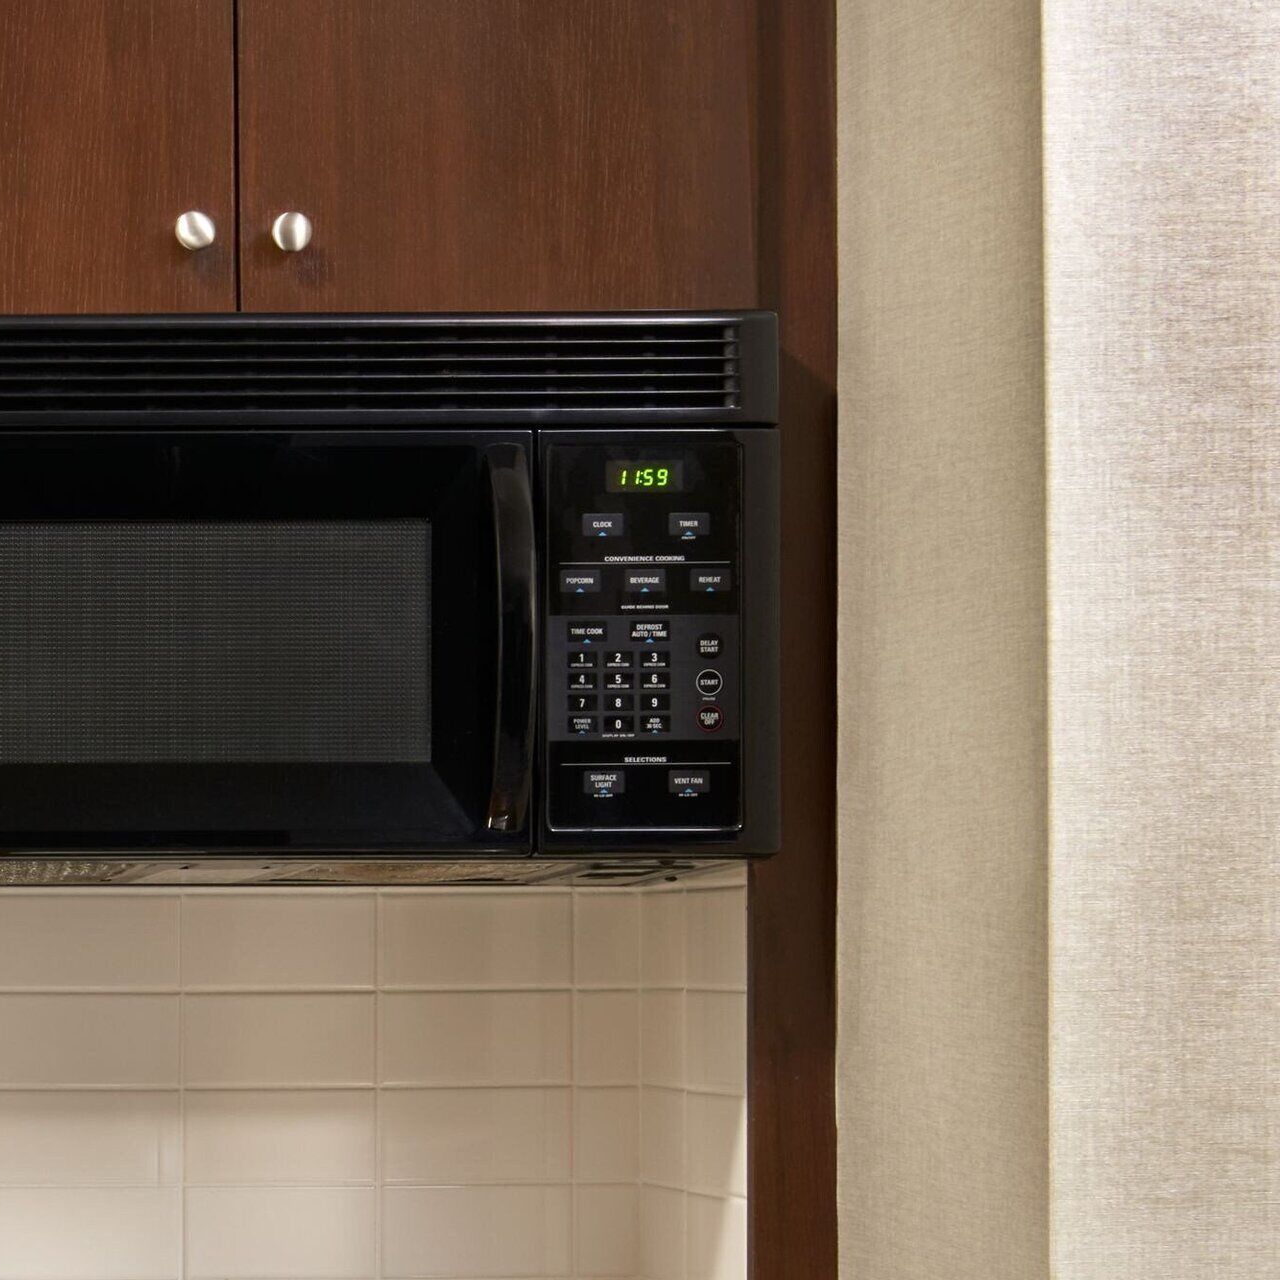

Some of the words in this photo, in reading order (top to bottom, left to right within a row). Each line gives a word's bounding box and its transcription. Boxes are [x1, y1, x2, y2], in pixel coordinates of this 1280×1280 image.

[621, 469, 668, 486] 11:59
[579, 654, 584, 662] 1
[615, 654, 621, 662] 2
[652, 653, 657, 662] 3
[579, 675, 585, 683] 4
[615, 675, 621, 683] 5
[652, 675, 657, 683] 6
[579, 699, 585, 707] 7
[615, 699, 621, 707] 8
[652, 699, 657, 707] 9
[616, 720, 621, 728] 0
